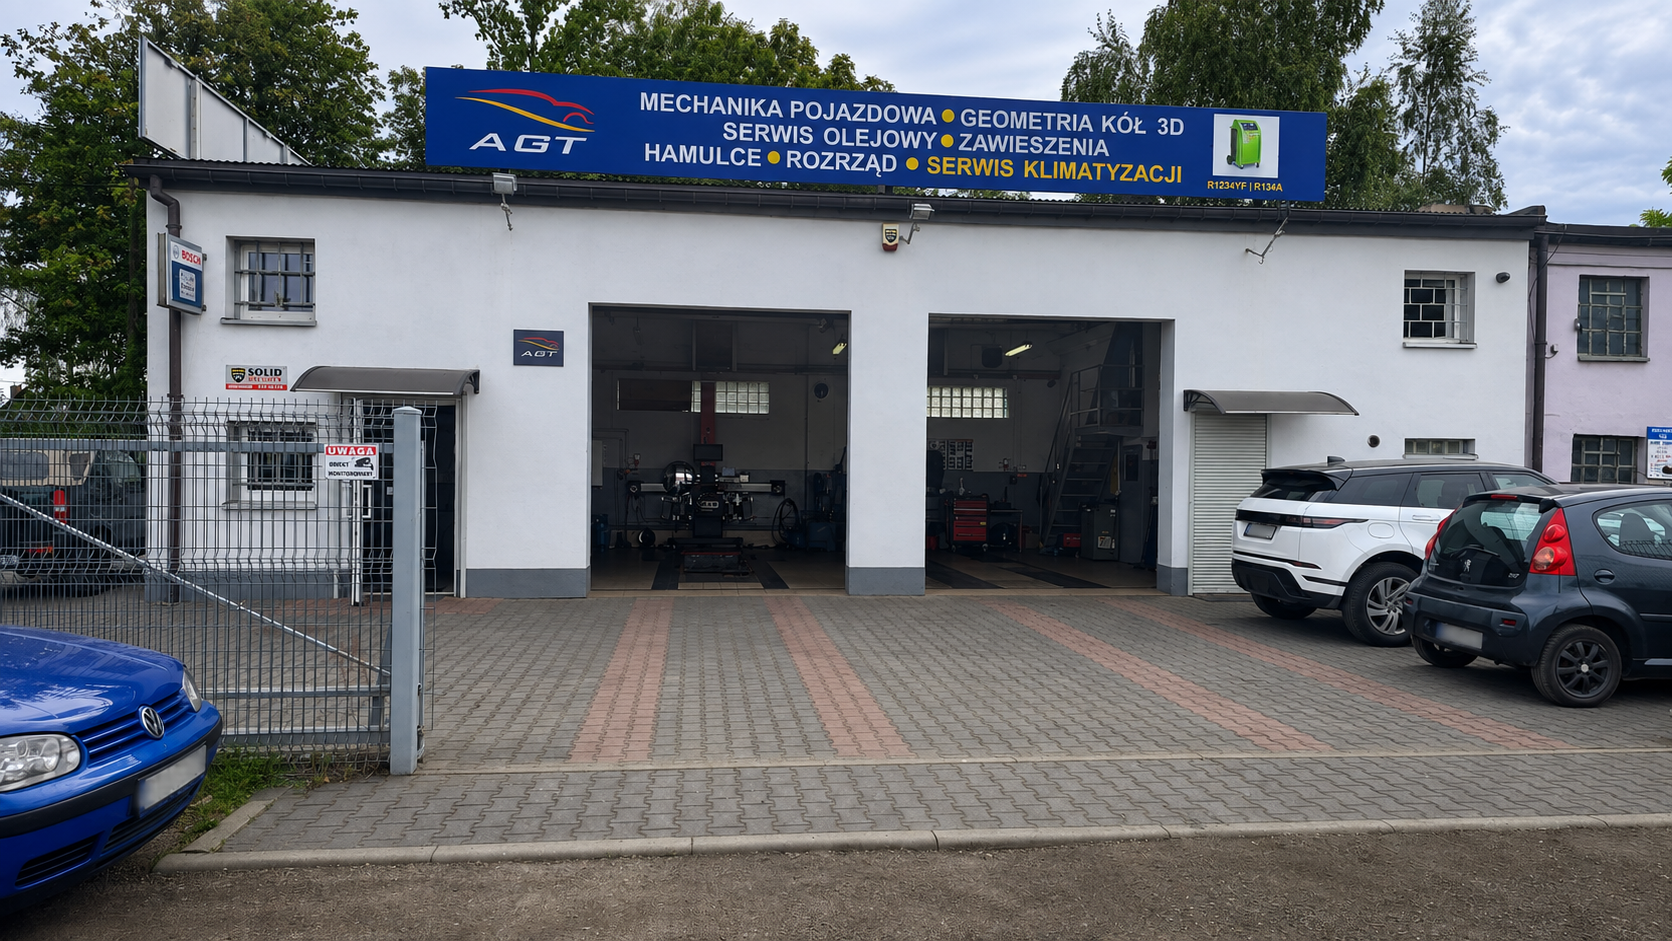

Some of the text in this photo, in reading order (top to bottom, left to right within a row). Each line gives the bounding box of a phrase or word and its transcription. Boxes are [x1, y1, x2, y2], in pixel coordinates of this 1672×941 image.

[640, 92, 937, 125] MECHANIKA POJAZDOWA
[960, 108, 1185, 136] GEOMETRIA KÓŁ 3D
[468, 132, 588, 155] AGT
[723, 121, 938, 150] SERWIS OLEJOWY
[958, 133, 1110, 157] ZAWIESZENIA
[644, 143, 897, 177] HAMULCE ROZRZĄD
[926, 156, 1182, 184] SERWIS KLIMATYZACJI
[1207, 180, 1247, 191] R1234YF
[181, 249, 201, 265] BOSCH
[248, 368, 282, 377] SOLID
[327, 446, 375, 456] UWAGA
